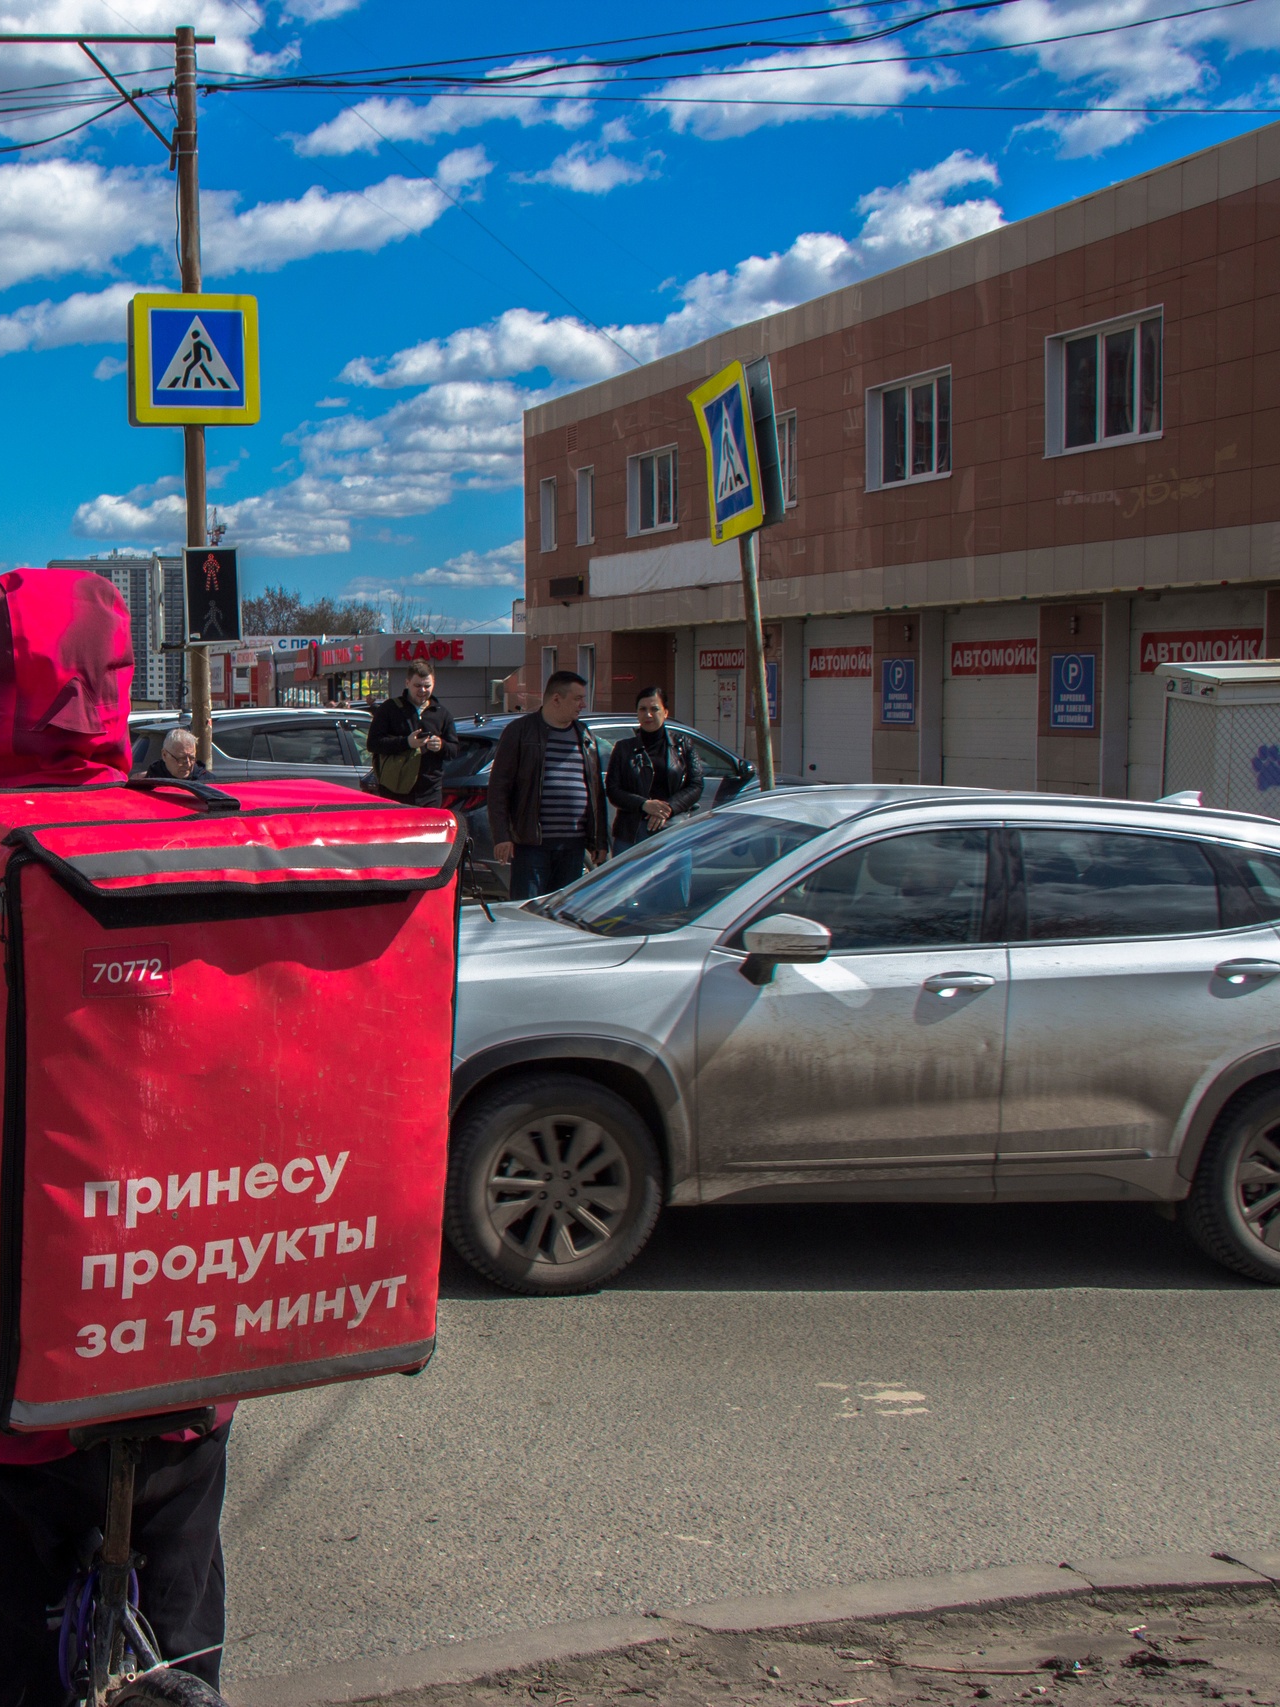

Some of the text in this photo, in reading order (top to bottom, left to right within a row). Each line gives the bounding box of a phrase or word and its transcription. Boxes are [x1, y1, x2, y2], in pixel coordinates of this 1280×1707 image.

[278, 639, 288, 649] С
[395, 640, 464, 661] КАФЕ
[1054, 704, 1091, 713] ДЛЯ КЛИЕНТОВ
[1060, 694, 1085, 702] ПАРКОВКА
[1057, 714, 1087, 722] АВТОМОЙКИ
[92, 958, 163, 983] 70772
[83, 1150, 350, 1229] принесу
[81, 1215, 378, 1300] продукты
[75, 1274, 408, 1358] за 15 минут
